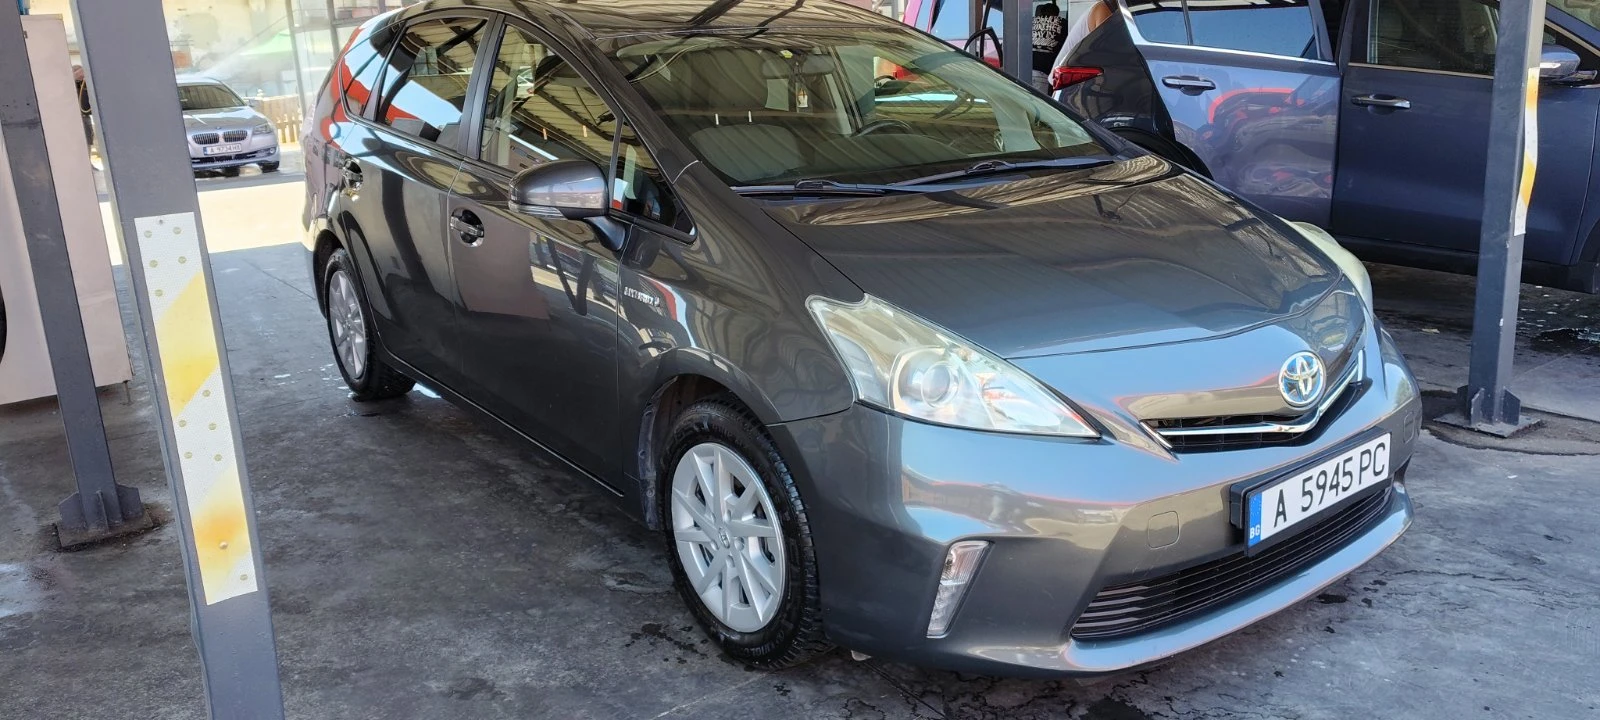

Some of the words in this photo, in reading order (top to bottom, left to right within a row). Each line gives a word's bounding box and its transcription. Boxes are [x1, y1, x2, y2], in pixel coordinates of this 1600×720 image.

[1274, 489, 1287, 528] A
[1301, 456, 1354, 513] 5945
[1358, 442, 1386, 486] PC
[1249, 524, 1260, 539] BG
